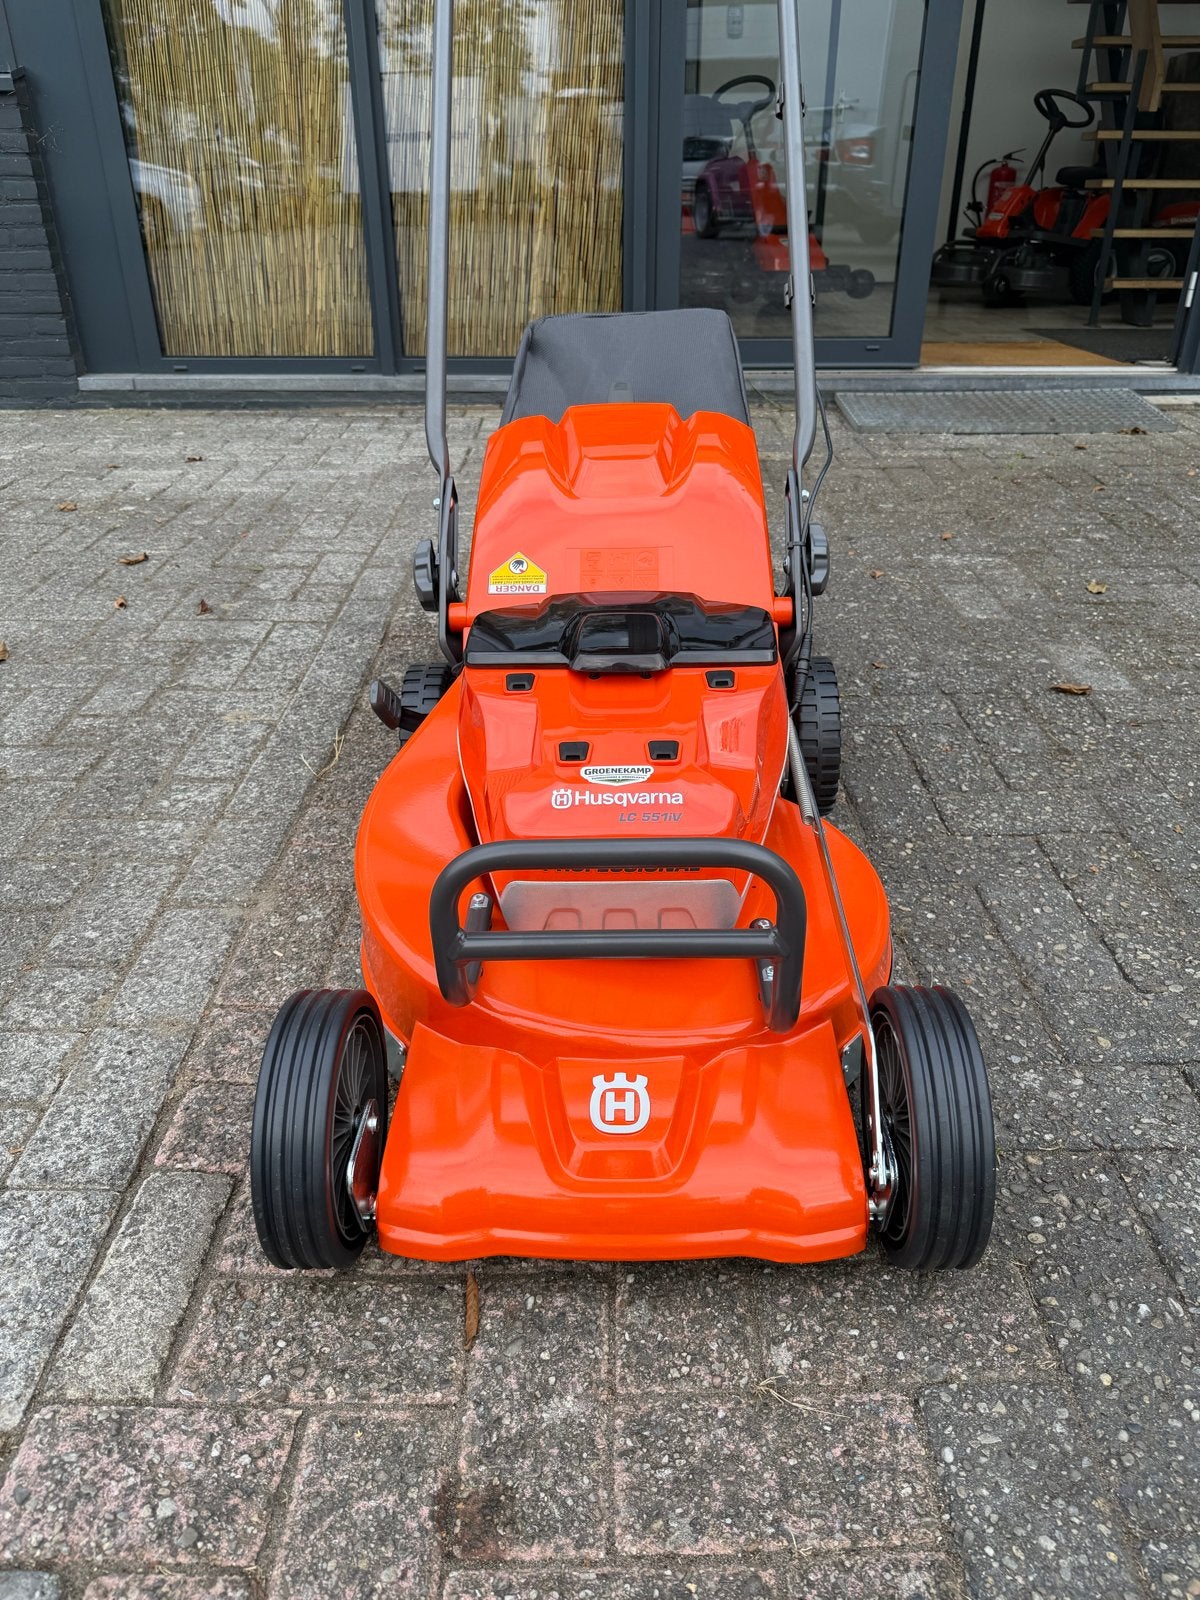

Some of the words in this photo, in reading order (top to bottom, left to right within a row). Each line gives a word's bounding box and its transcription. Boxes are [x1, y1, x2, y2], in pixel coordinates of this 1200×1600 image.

[584, 767, 651, 775] GROENEKAMP
[575, 790, 683, 807] Husqvarna
[619, 812, 637, 822] LC
[642, 812, 682, 822] 551iV
